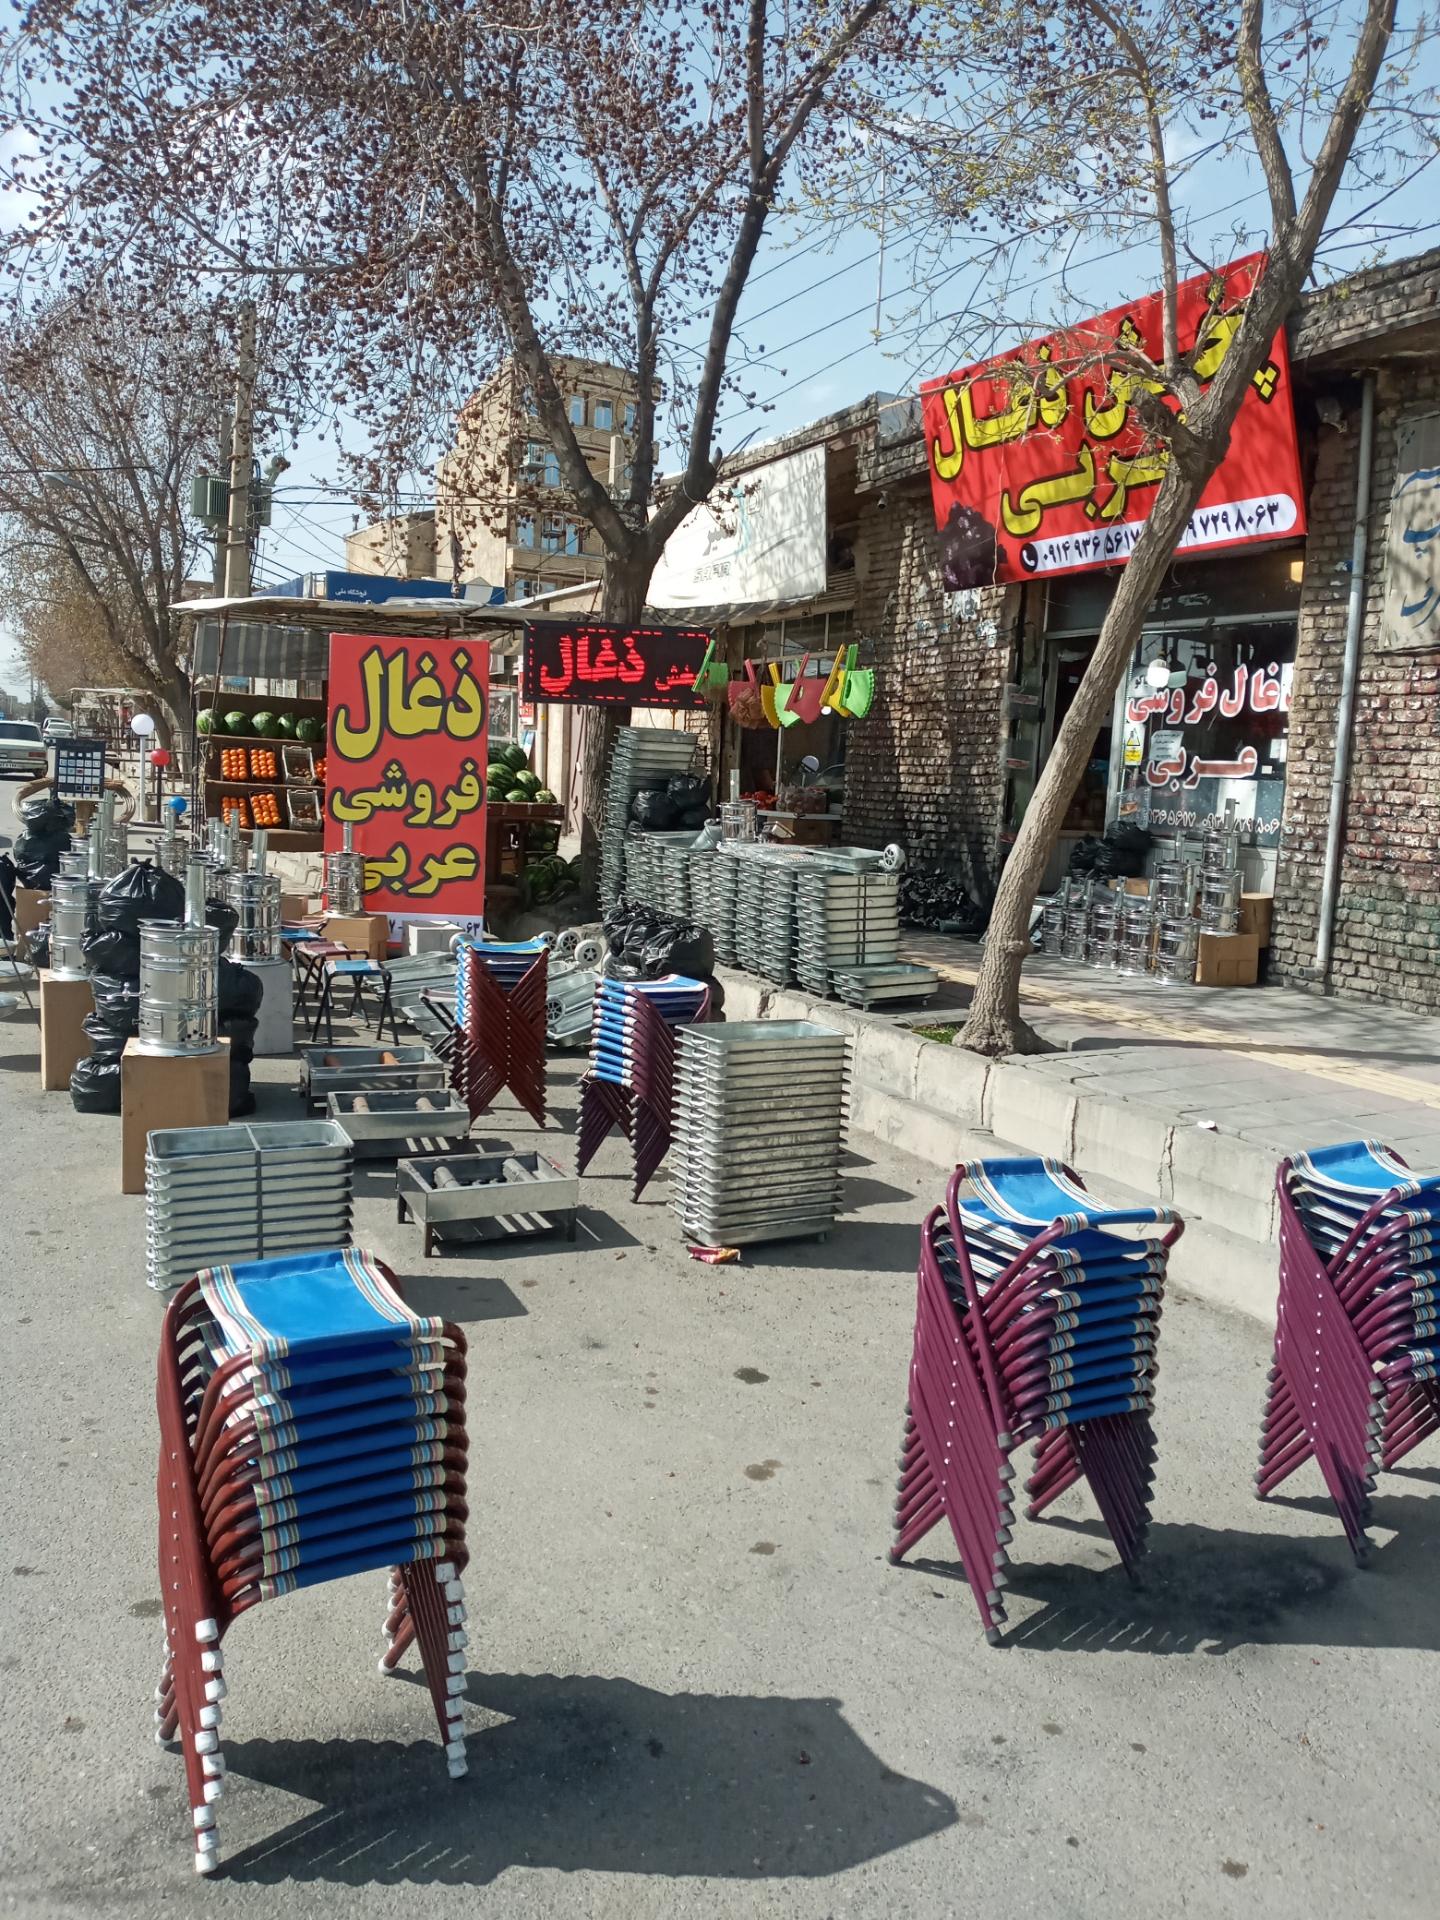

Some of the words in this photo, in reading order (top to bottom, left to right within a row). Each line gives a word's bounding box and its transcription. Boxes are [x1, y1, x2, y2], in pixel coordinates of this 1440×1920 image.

[1084, 274, 1282, 440] خش
[932, 340, 1070, 480] ذغال
[1000, 438, 1176, 537] ربی
[1073, 537, 1101, 560] ۹۳۶
[1235, 501, 1280, 532] ۸۰۶۳
[540, 634, 645, 693] ذغال
[655, 664, 700, 691] خش
[1219, 661, 1292, 718] غال
[333, 645, 486, 762] ذغال
[331, 758, 481, 826] فروشی
[1146, 745, 1258, 792] عربی
